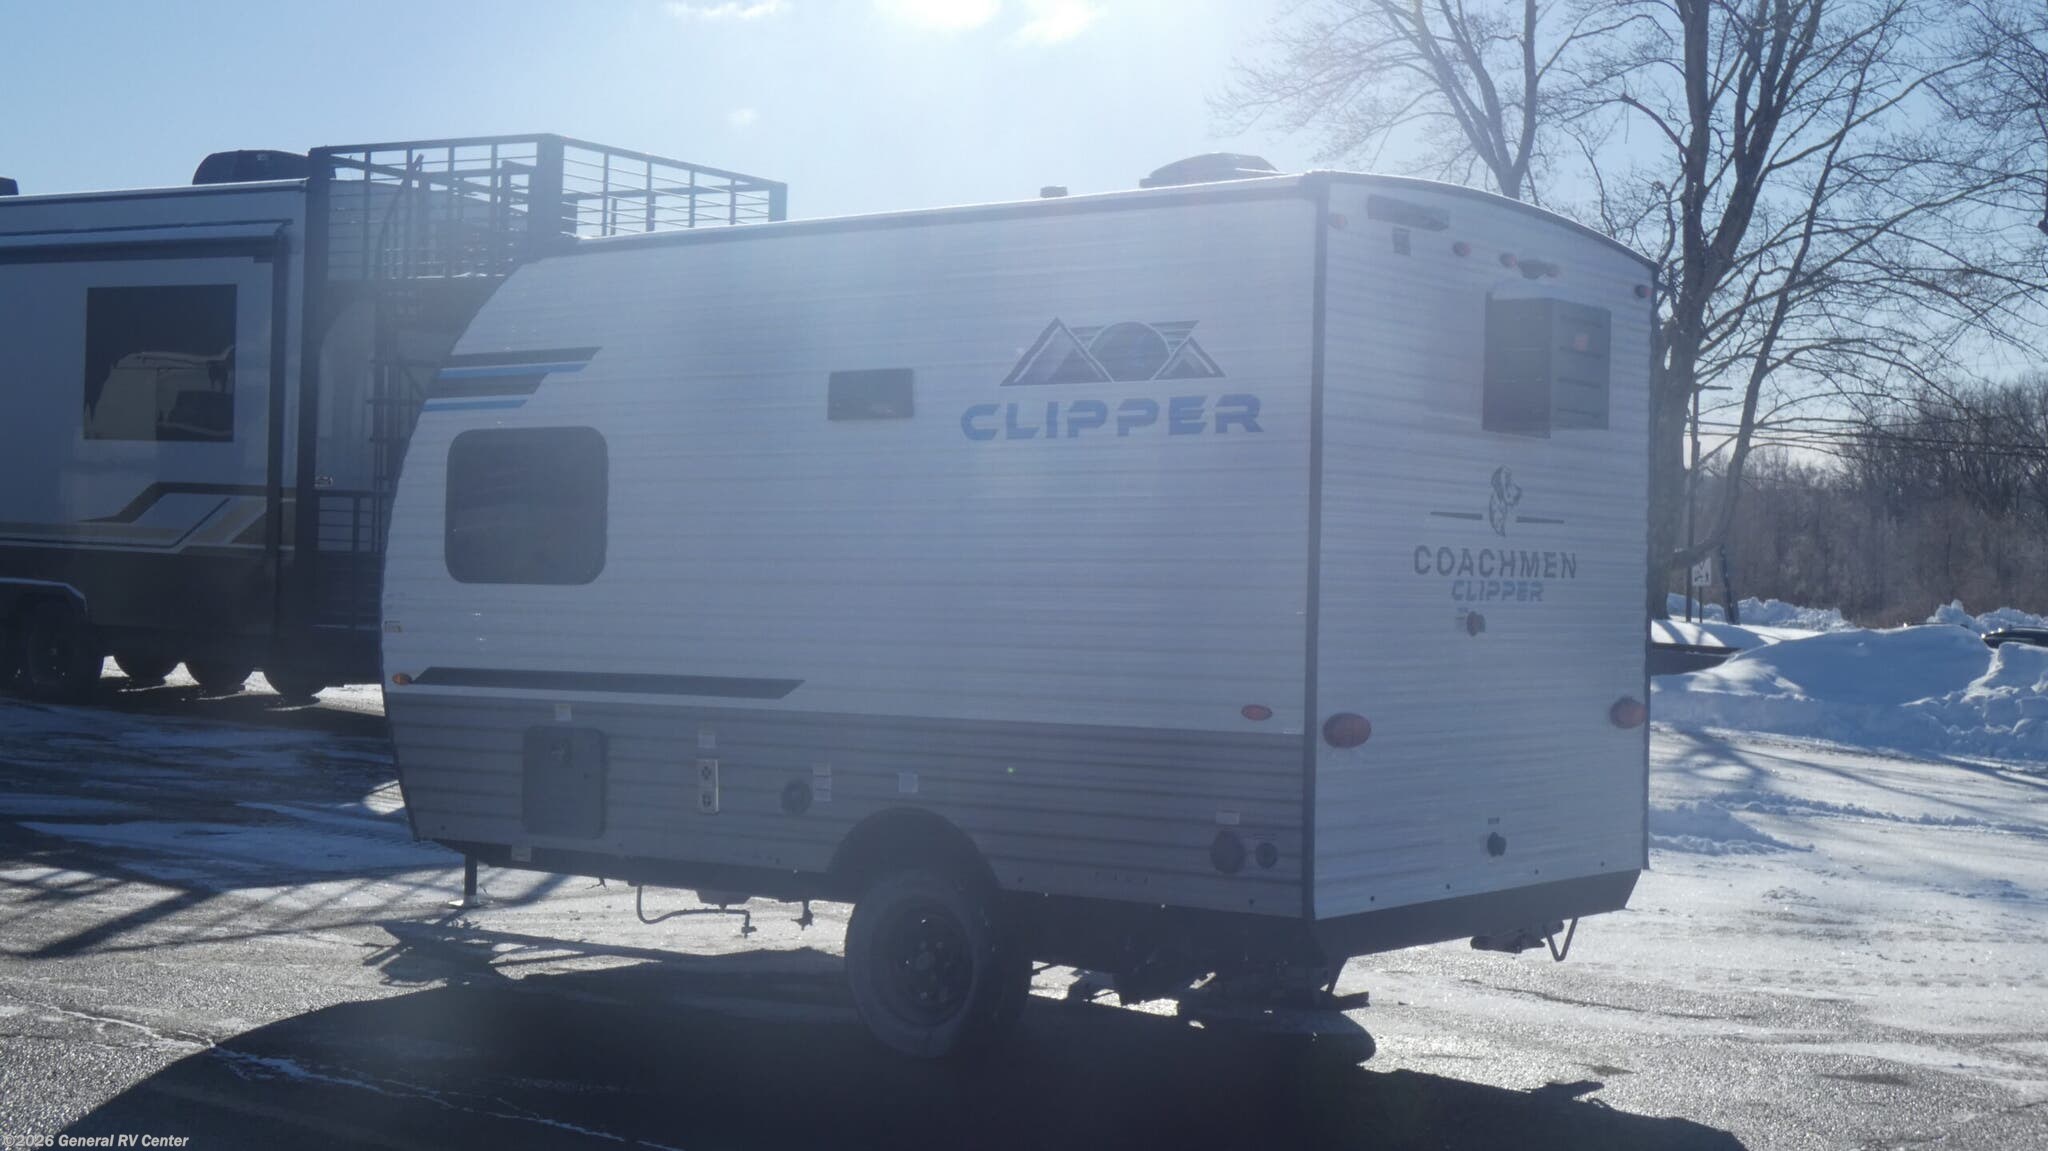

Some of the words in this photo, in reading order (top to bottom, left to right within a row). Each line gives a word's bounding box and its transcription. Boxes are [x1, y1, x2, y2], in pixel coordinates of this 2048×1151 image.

[960, 393, 1264, 441] CLIPPER
[1413, 545, 1577, 579] COACHMEN
[1452, 580, 1544, 602] CLIPPER
